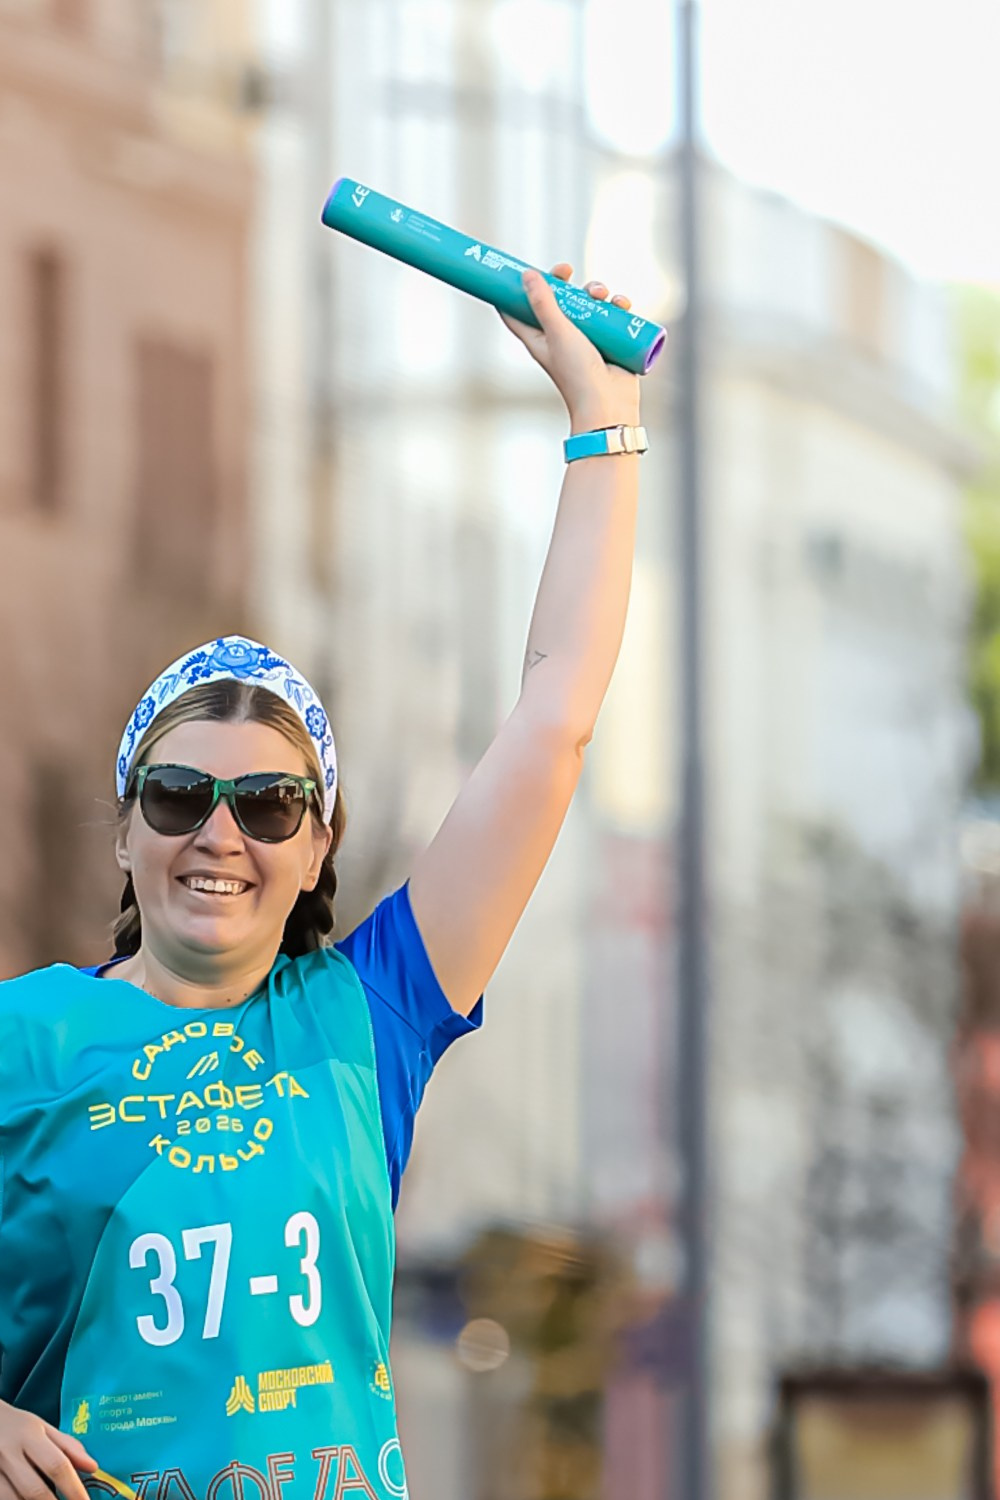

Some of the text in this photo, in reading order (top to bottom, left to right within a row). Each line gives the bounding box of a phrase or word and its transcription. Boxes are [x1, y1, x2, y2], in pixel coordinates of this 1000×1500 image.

[351, 184, 371, 208] 37
[627, 316, 646, 340] 37
[131, 1021, 265, 1081] САДОВОЕ
[88, 1070, 310, 1131] ЭСТАФЕТА
[176, 1114, 244, 1135] 2026
[148, 1117, 274, 1174] КОЛЬЦО
[128, 1211, 323, 1347] 37-3
[258, 1359, 334, 1391] МОСКОВСКИЙ
[258, 1388, 297, 1413] СПОРТ
